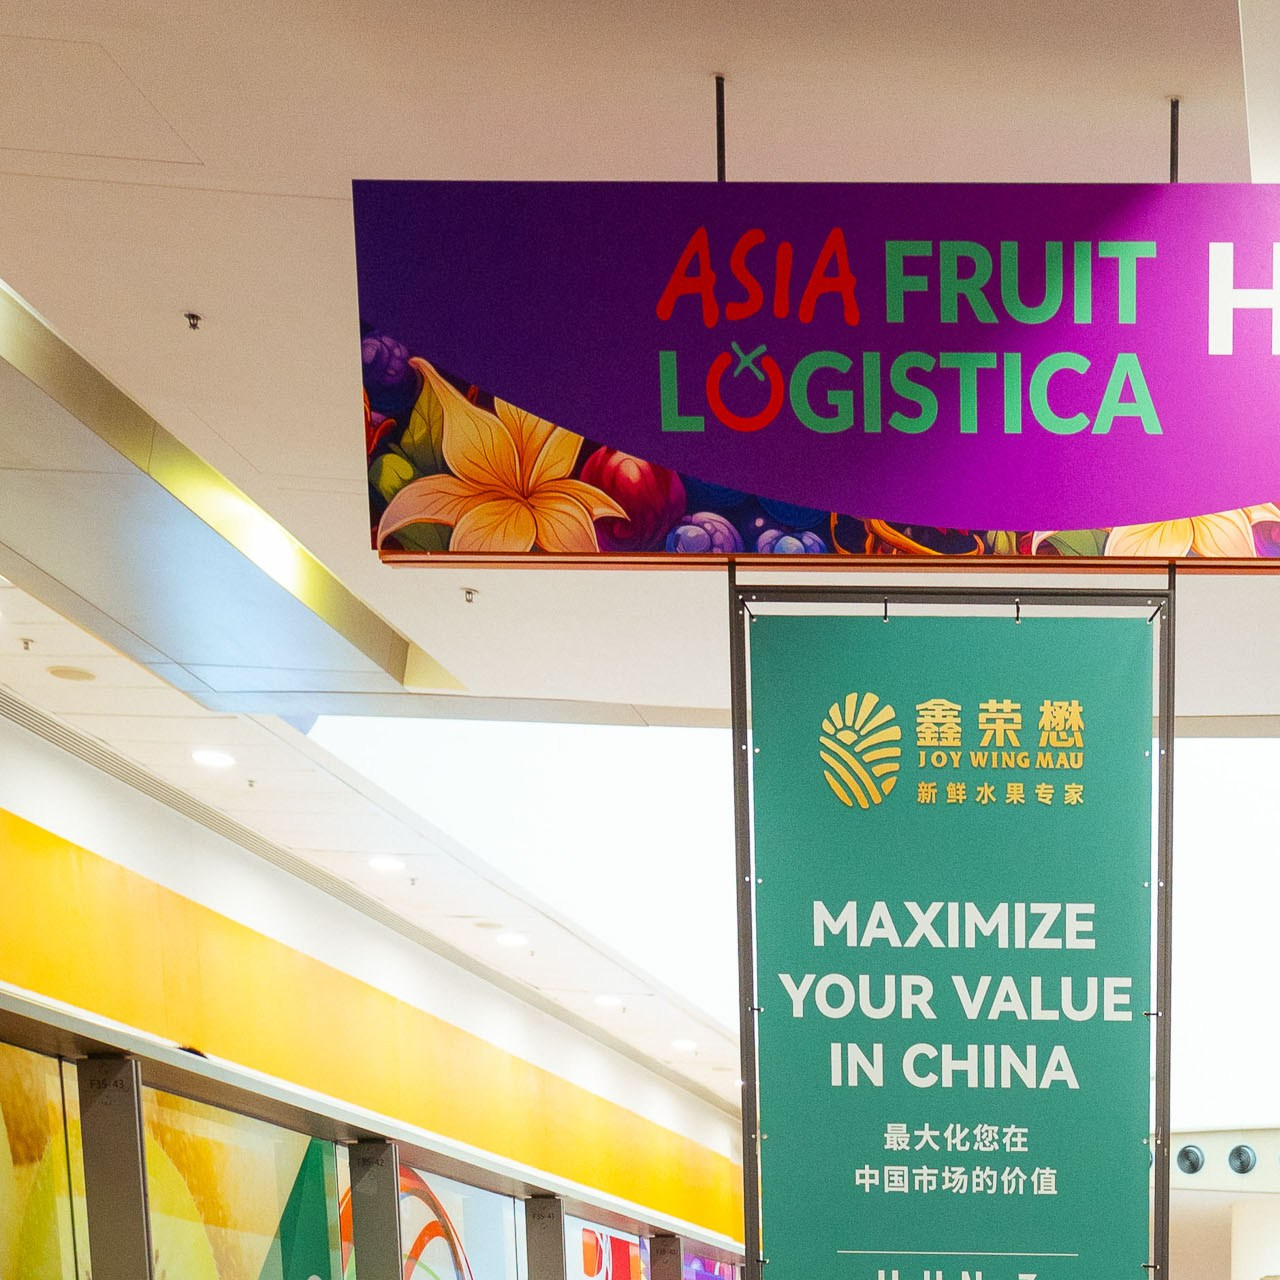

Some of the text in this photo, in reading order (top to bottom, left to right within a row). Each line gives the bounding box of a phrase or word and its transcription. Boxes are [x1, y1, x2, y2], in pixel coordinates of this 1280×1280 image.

[656, 225, 1157, 328] ASIA FRUIT
[659, 341, 1163, 435] LOGISTICA
[916, 699, 1084, 748] 鑫荣懋
[919, 751, 1084, 769] JOY WING MAU
[917, 781, 1084, 805] 新鲜水果专家
[813, 900, 1096, 950] MAXIMIZE
[778, 973, 1133, 1021] YOUR VALUE
[831, 1043, 1080, 1089] IN CHINA
[883, 1123, 1029, 1153] 最大化您在
[855, 1165, 1058, 1195] 中国市场的价值
